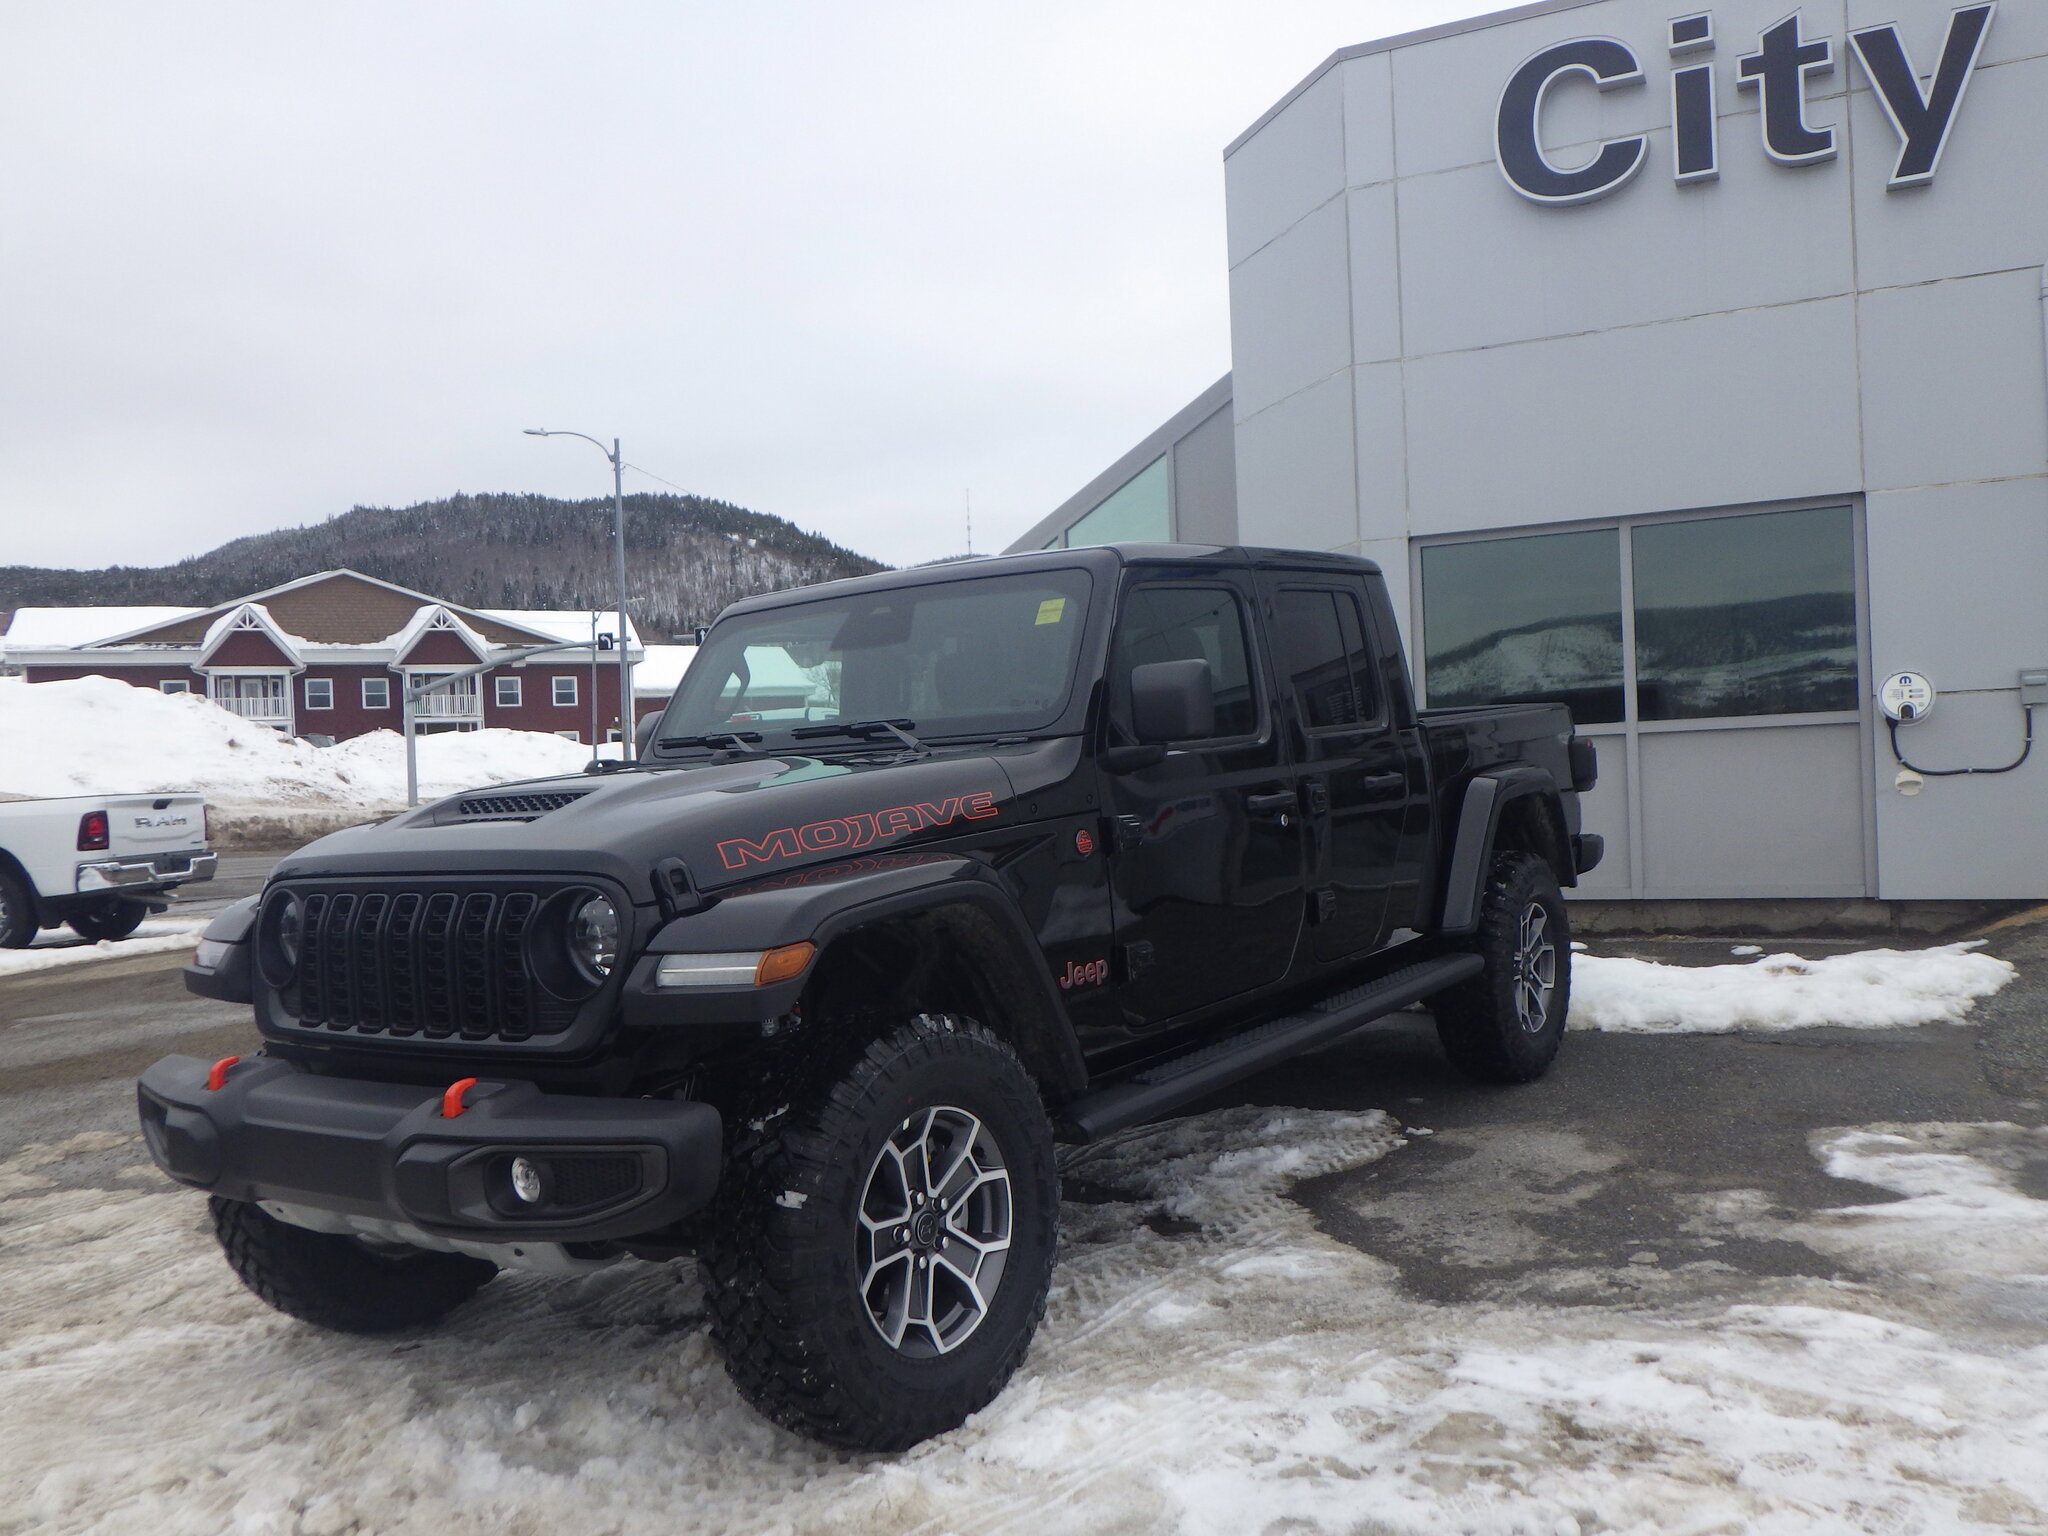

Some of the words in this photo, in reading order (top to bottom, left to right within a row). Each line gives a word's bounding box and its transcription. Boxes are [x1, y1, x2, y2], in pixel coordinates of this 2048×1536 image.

[1494, 2, 1997, 207] City
[134, 815, 187, 828] RAM
[716, 791, 998, 869] MOJAVE
[1060, 959, 1108, 989] Jeep
